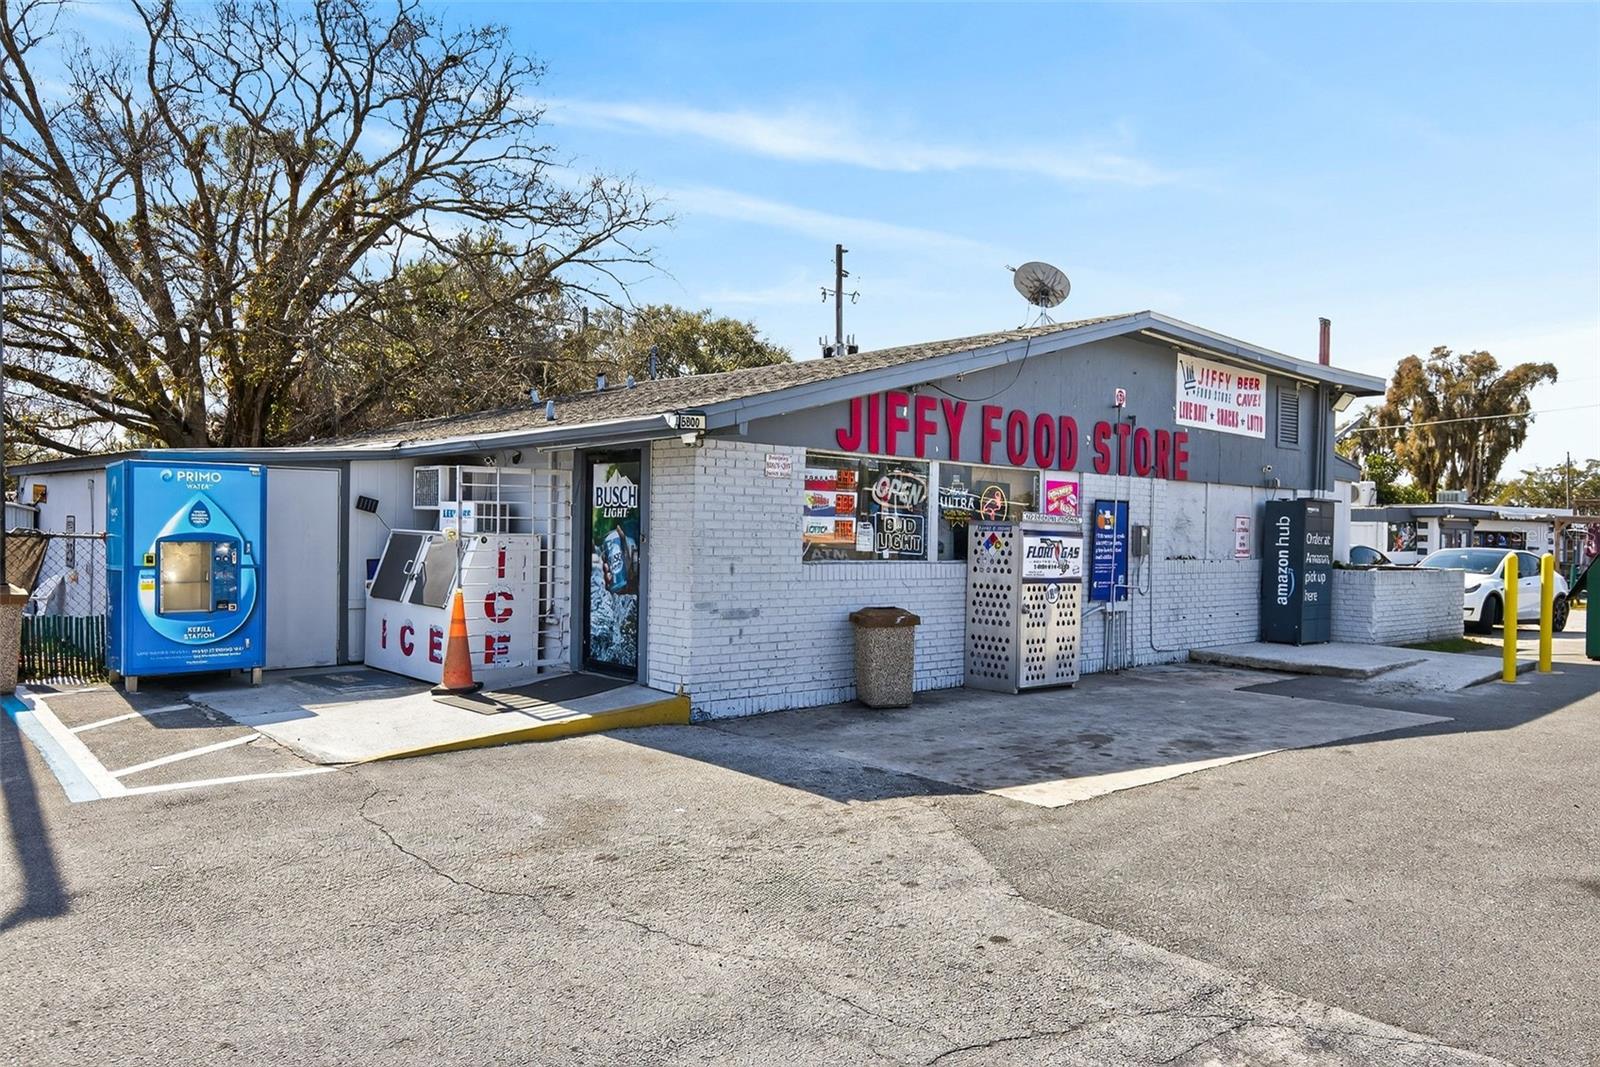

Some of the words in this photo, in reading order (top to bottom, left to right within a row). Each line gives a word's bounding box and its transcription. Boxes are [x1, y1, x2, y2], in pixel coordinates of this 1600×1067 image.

[1198, 367, 1232, 391] JIFFY
[1237, 376, 1261, 391] BEER
[1236, 393, 1261, 407] CAVE!
[681, 416, 700, 428] 5800
[1179, 401, 1193, 420] LIVE
[1217, 408, 1239, 428] SNACKS
[1247, 414, 1263, 433] LOTTO
[836, 391, 967, 461] JIFFY
[982, 404, 1078, 471] FOOD
[1092, 421, 1190, 481] STORE
[177, 471, 222, 482] PRIMO
[595, 485, 638, 508] BUSCH
[876, 476, 924, 506] OPEN
[940, 496, 975, 510] ULTRA
[604, 508, 628, 518] LIGHT
[884, 516, 917, 535] BUD
[1275, 516, 1290, 546] hub
[878, 533, 921, 551] LIGHT
[1306, 532, 1323, 545] Order
[1061, 547, 1080, 559] GAS
[1277, 550, 1289, 605] amazon
[1305, 570, 1317, 584] pick
[1318, 573, 1326, 584] up
[1304, 589, 1318, 602] here
[184, 632, 215, 640] STATION
[381, 613, 444, 665] ICE
